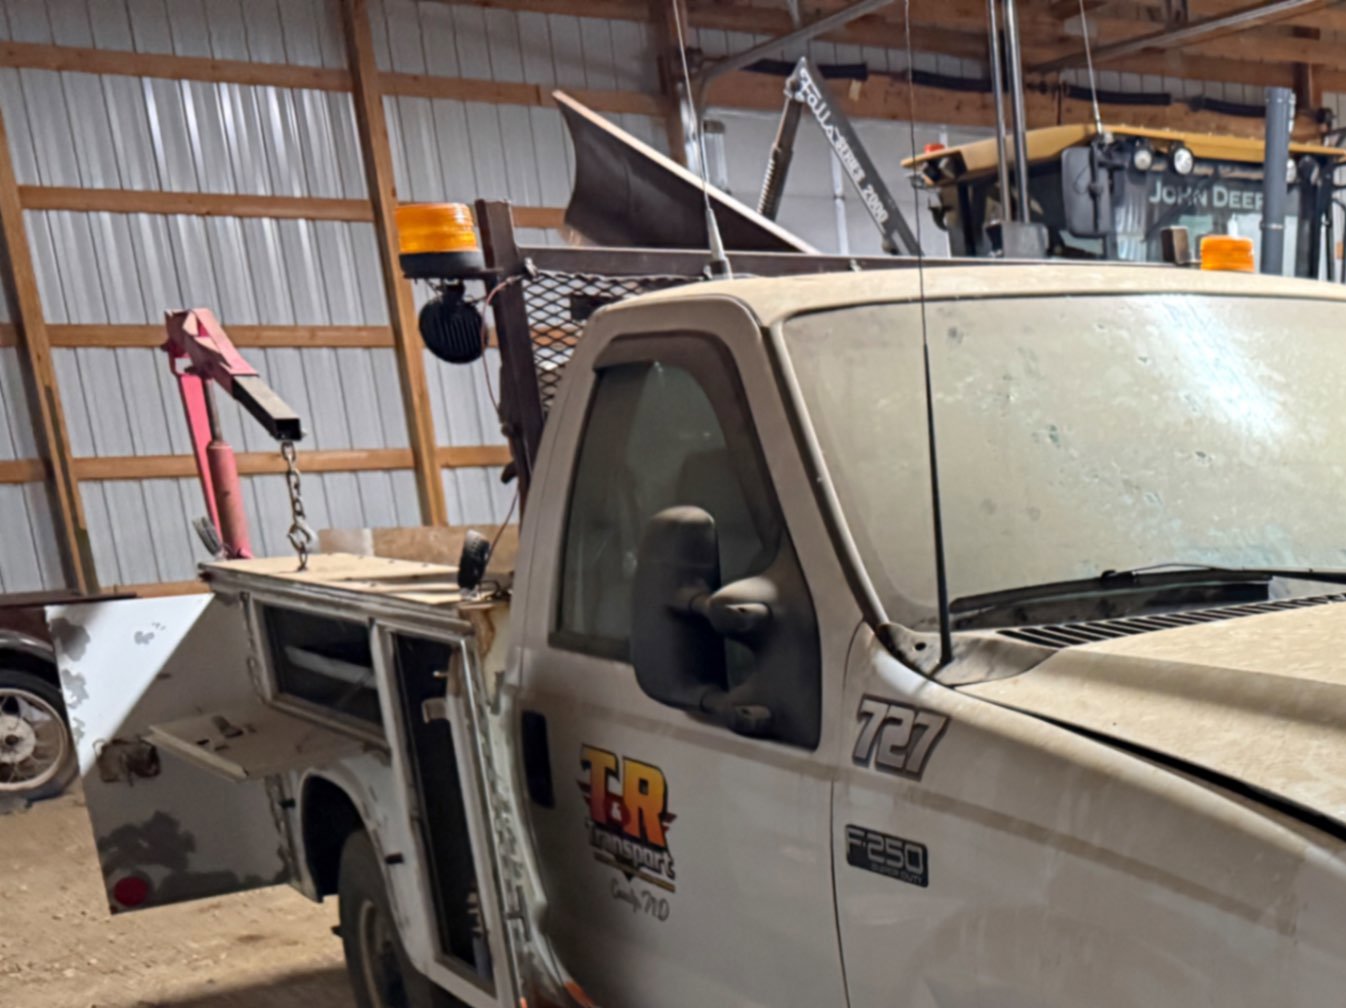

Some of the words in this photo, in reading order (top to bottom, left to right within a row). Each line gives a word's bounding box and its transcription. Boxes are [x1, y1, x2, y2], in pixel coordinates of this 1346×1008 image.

[861, 183, 890, 224] 2000
[1149, 180, 1208, 208] JOHN
[1212, 185, 1263, 210] DEER
[852, 694, 951, 783] 727
[585, 818, 676, 881] Transport
